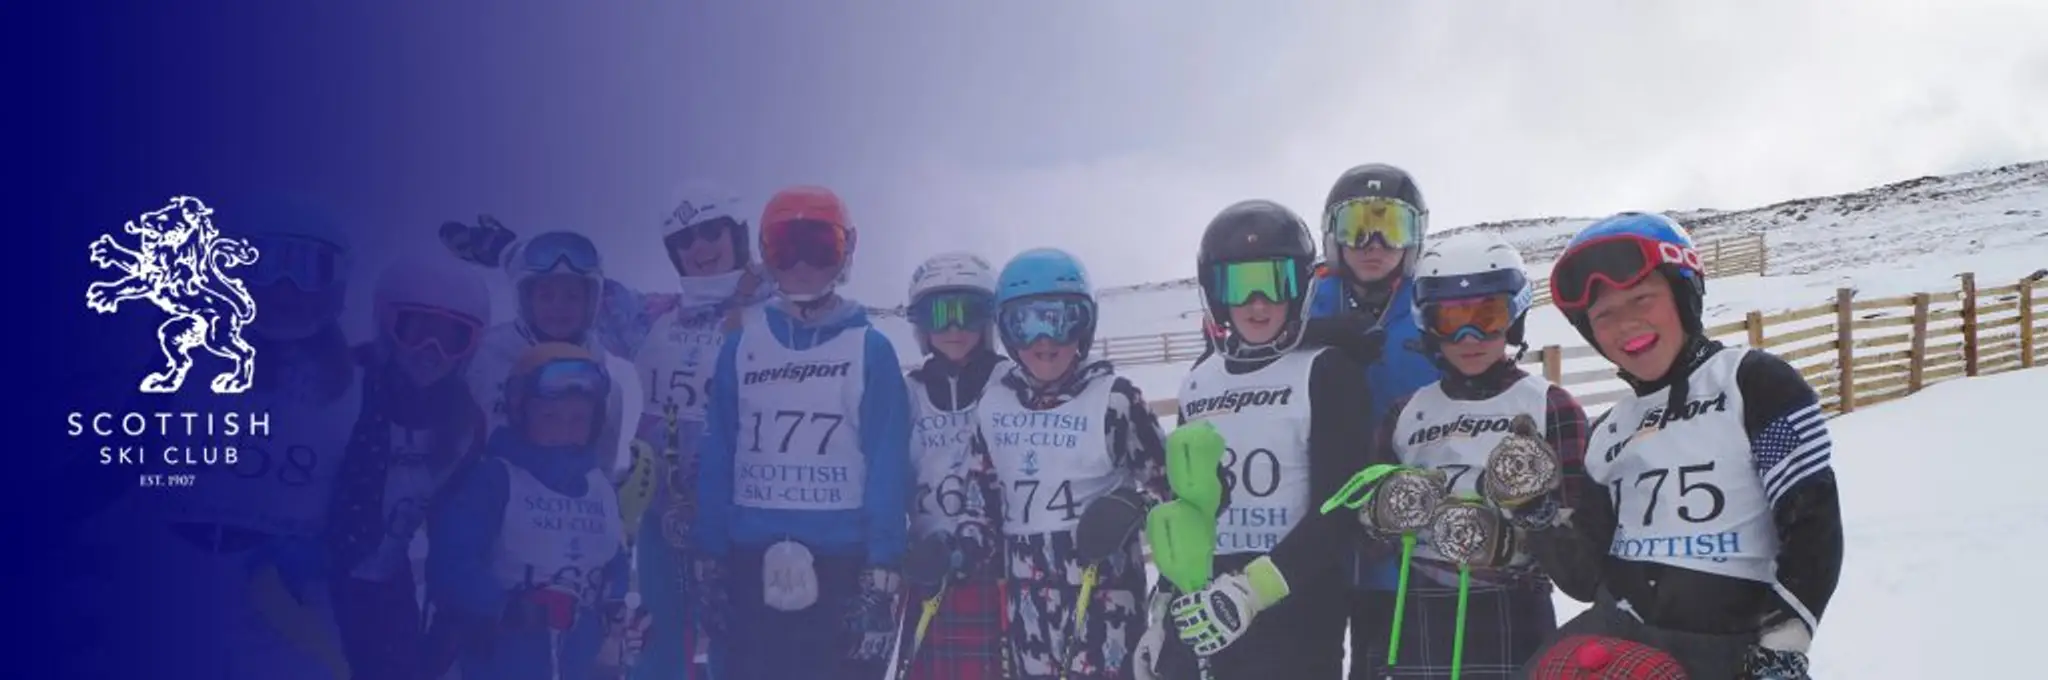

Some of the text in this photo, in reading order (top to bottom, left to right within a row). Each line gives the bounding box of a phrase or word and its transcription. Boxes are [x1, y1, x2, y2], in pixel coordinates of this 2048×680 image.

[743, 361, 851, 385] nevisport
[1185, 386, 1292, 418] nevisport
[749, 410, 844, 455] 177
[992, 412, 1088, 431] SCOTTISH
[1408, 414, 1512, 446] nevispo
[742, 464, 848, 482] SCOTTISH
[1611, 460, 1726, 527] 175
